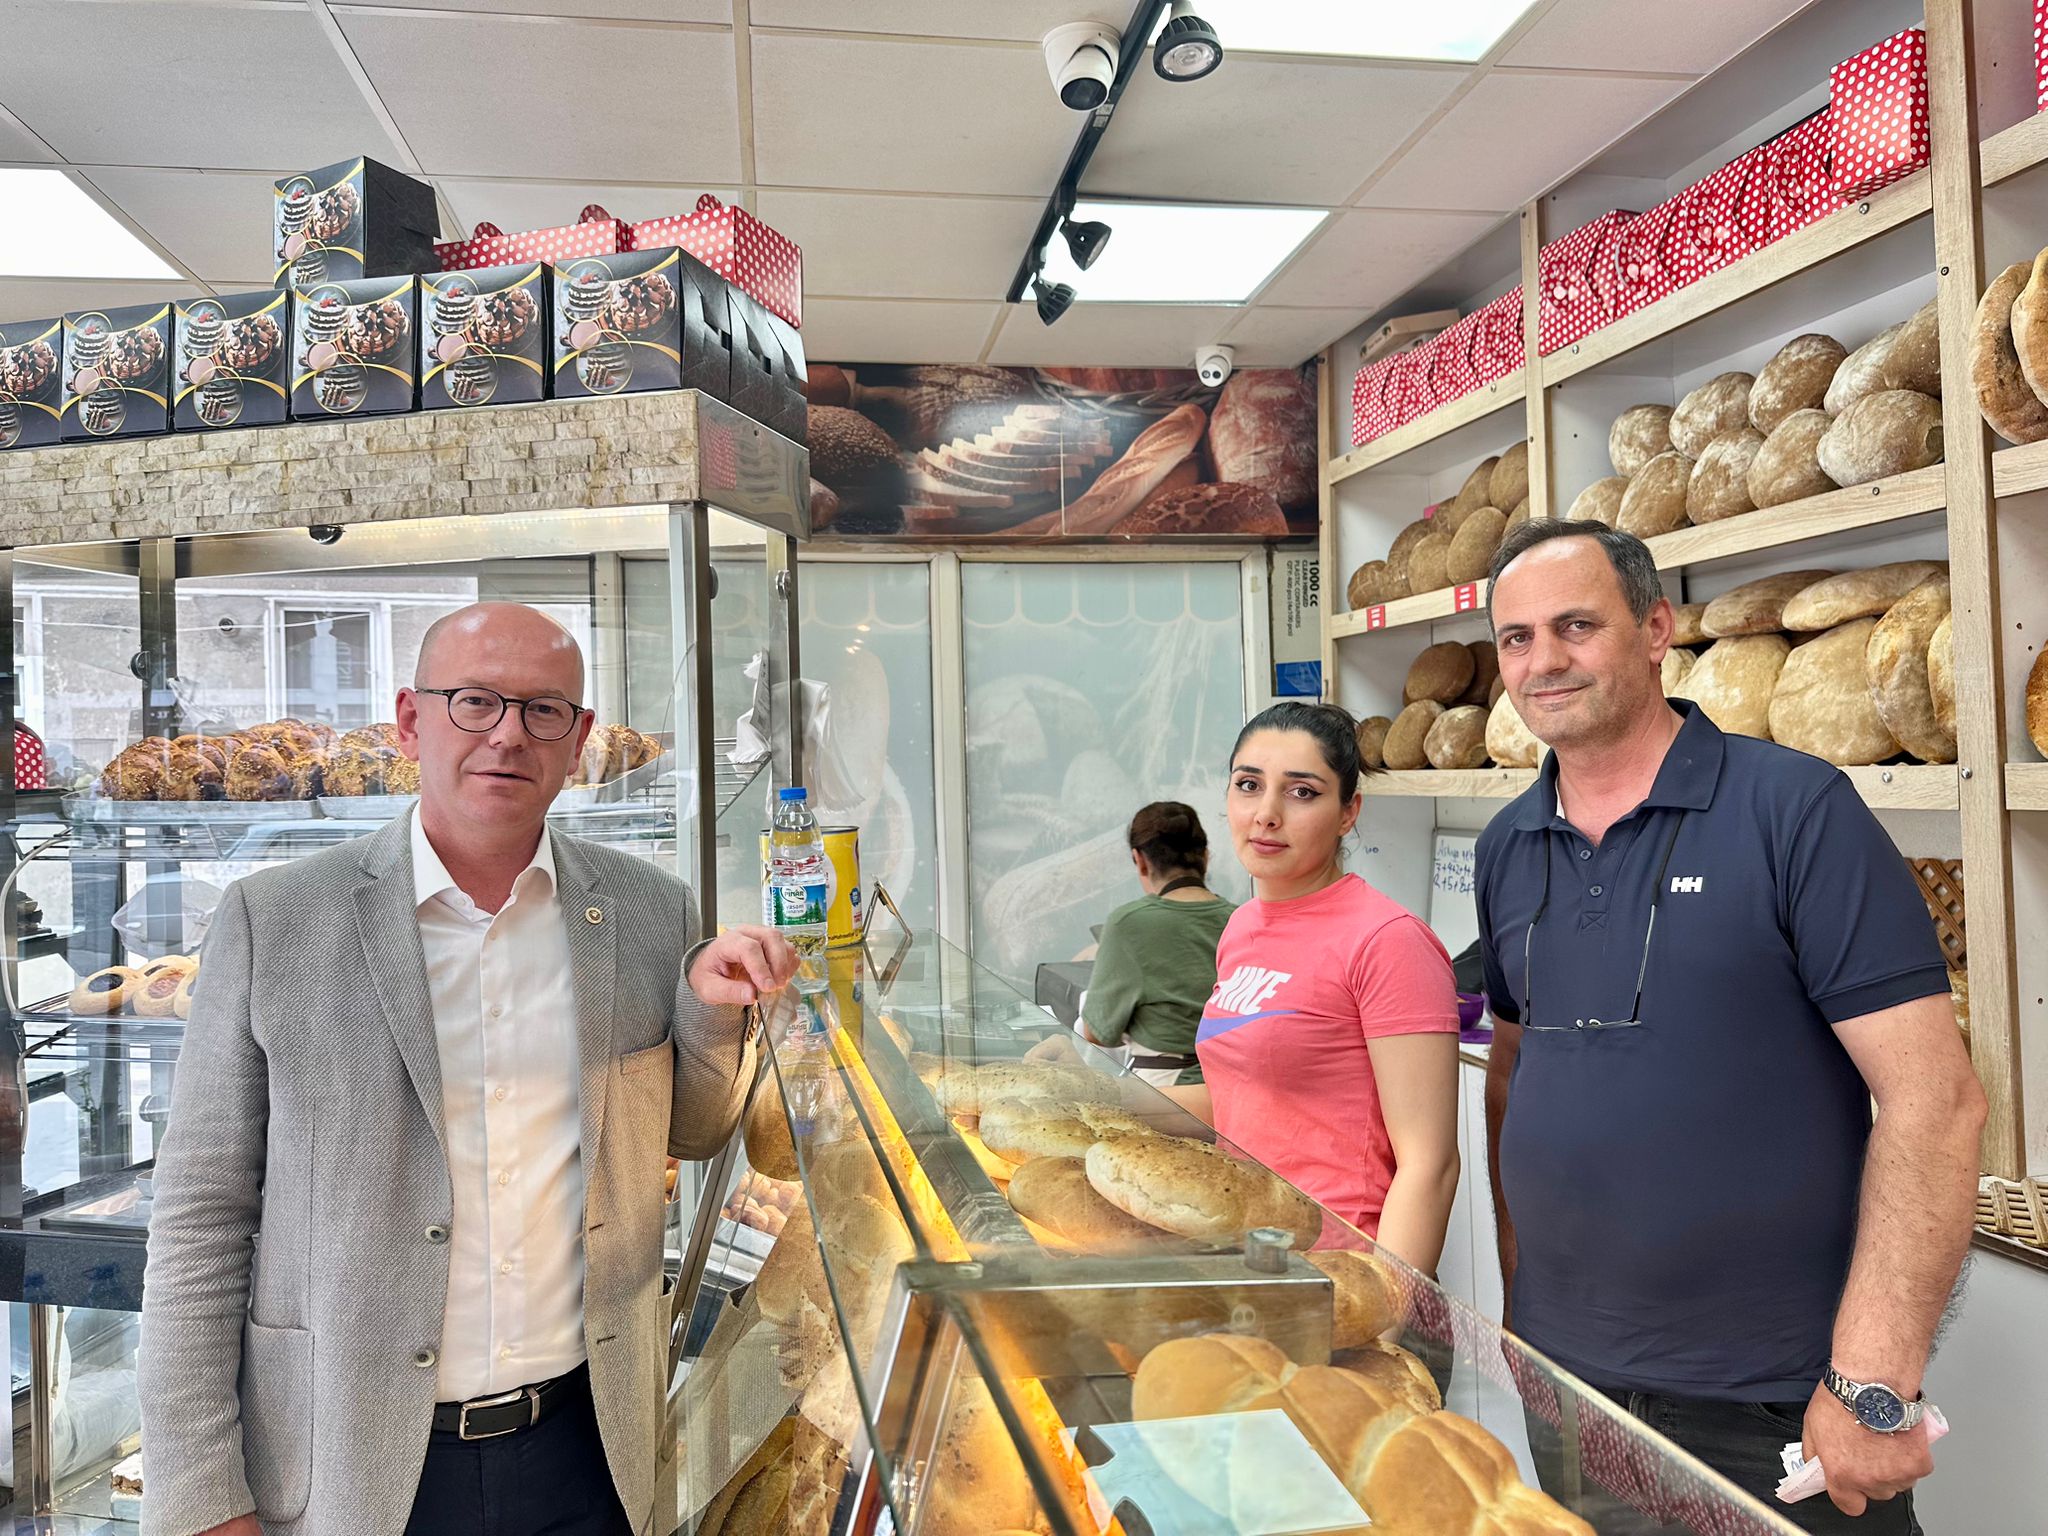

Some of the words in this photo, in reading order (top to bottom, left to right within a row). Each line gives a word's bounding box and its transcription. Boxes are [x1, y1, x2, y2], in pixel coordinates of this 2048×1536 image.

[1309, 559, 1320, 592] 1000
[1309, 593, 1318, 607] cc
[1670, 876, 1704, 893] HH
[1208, 966, 1293, 1016] NIKE
